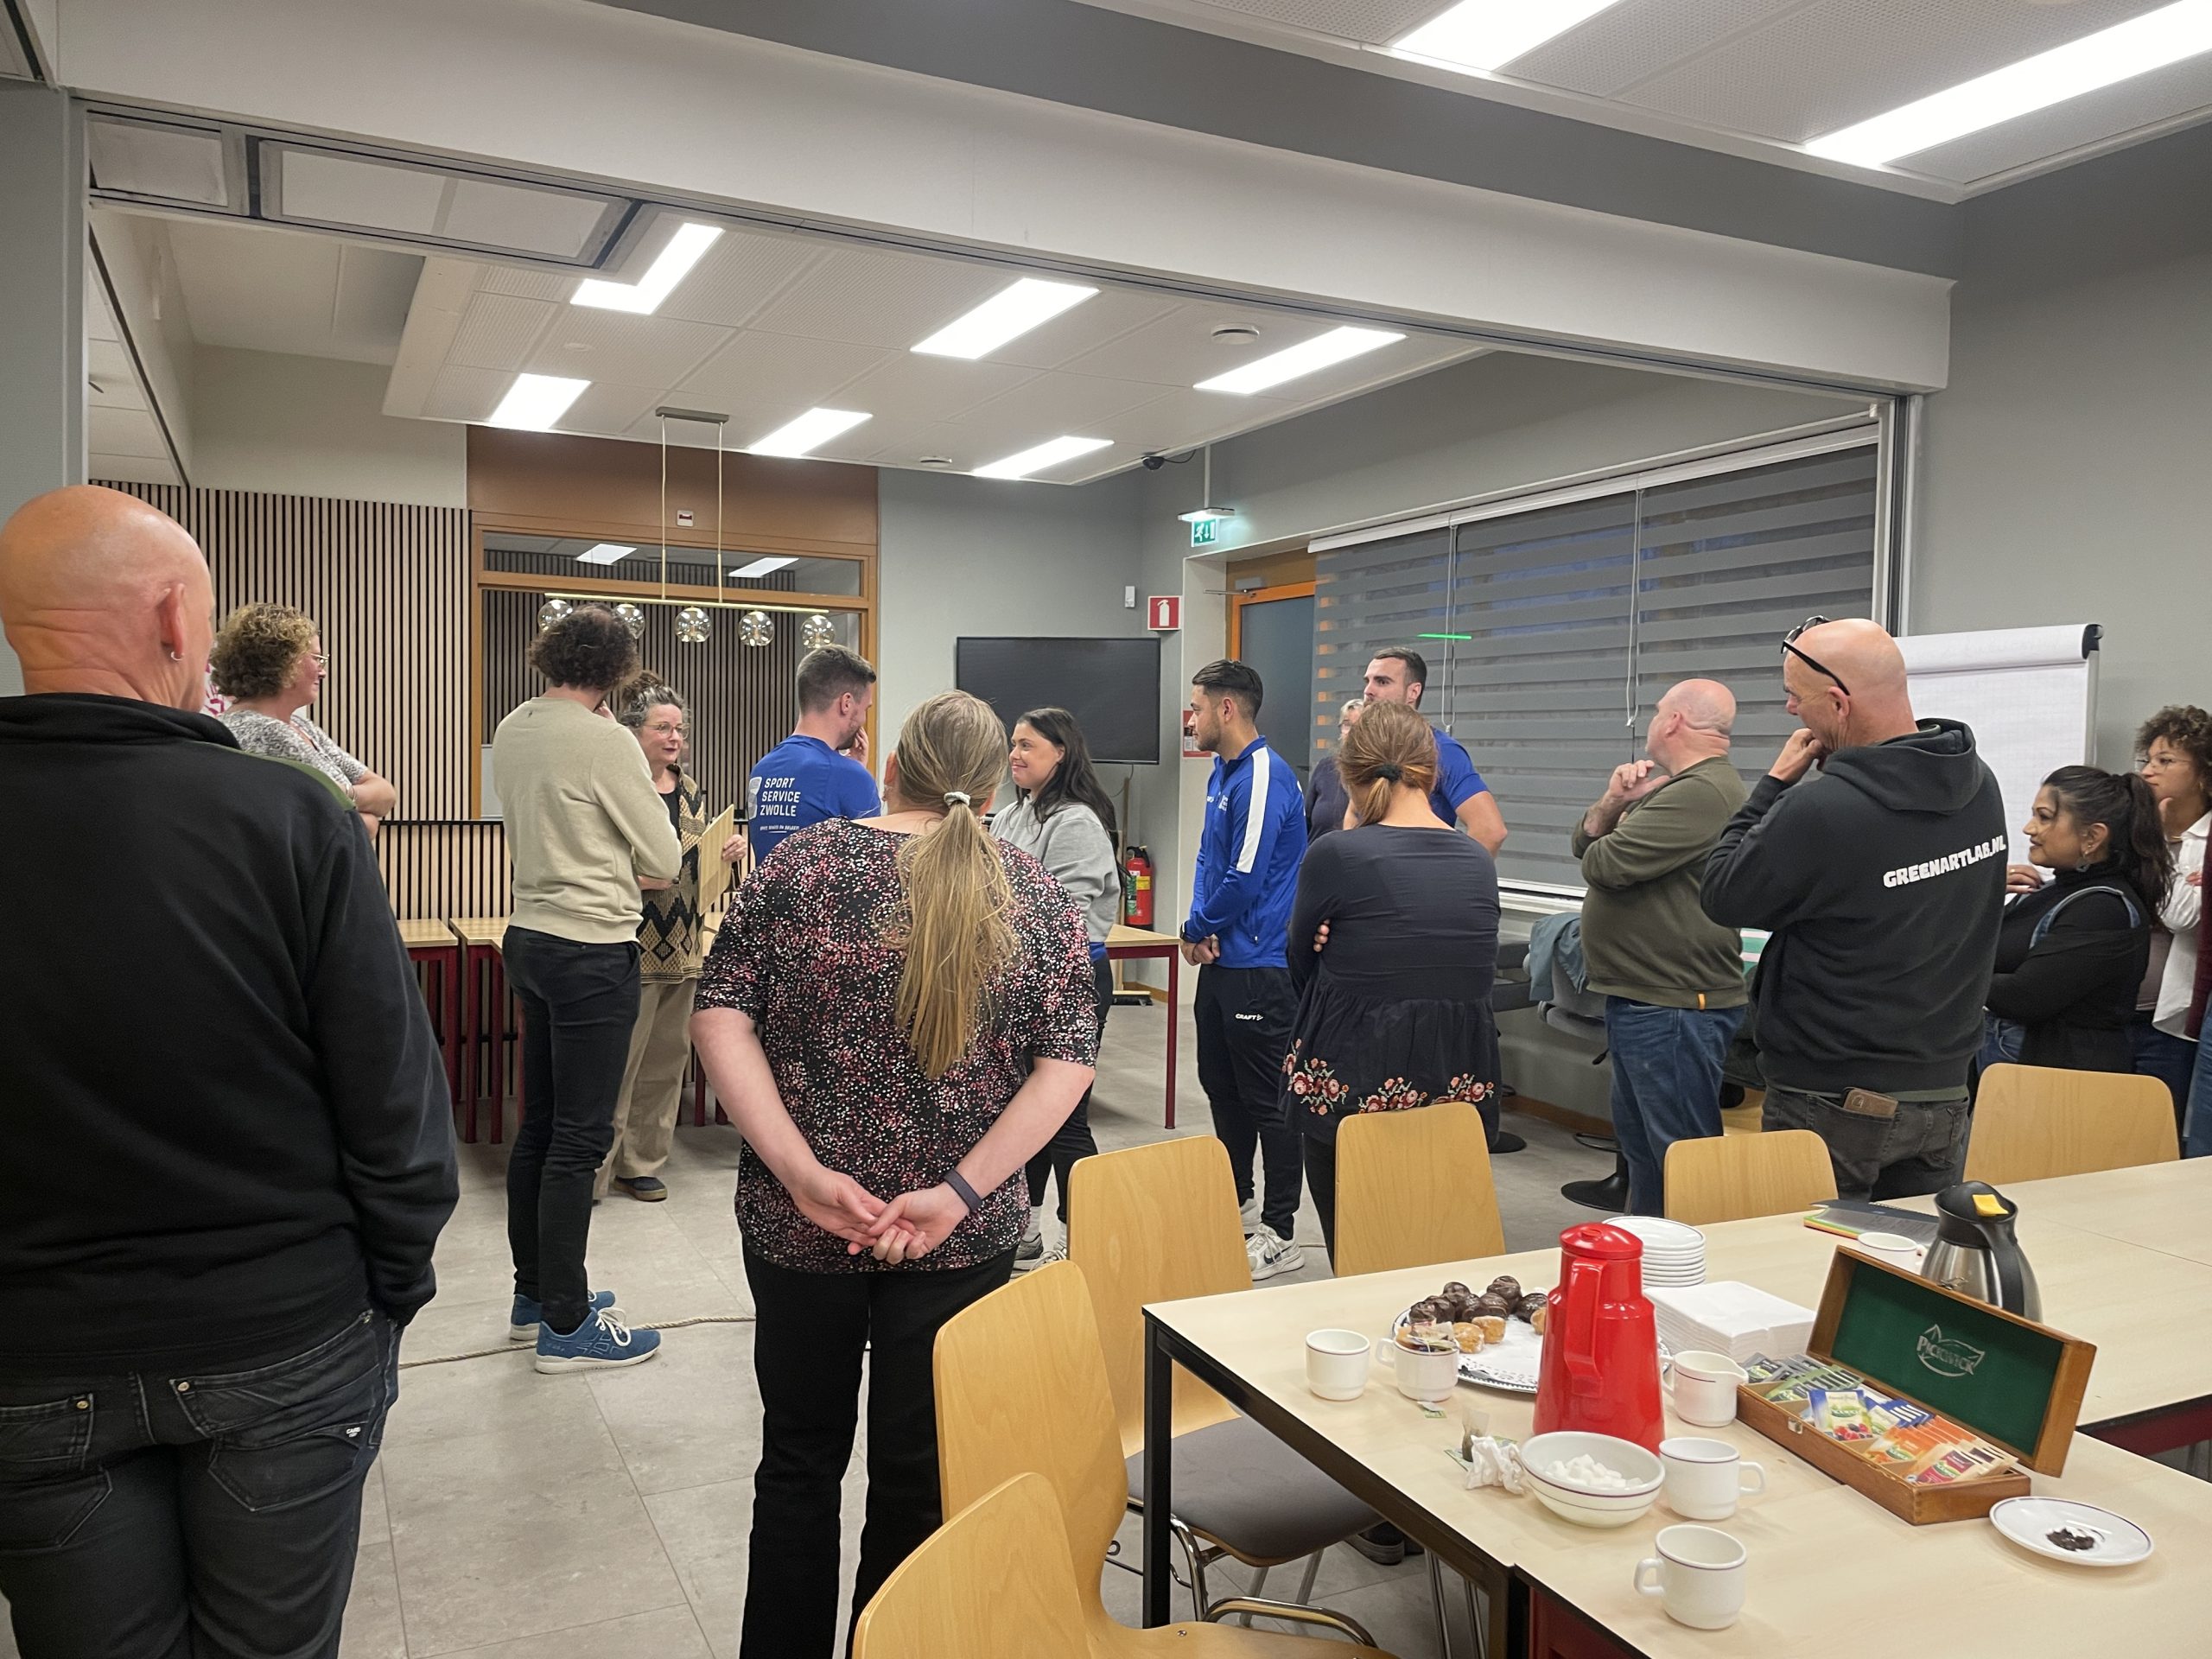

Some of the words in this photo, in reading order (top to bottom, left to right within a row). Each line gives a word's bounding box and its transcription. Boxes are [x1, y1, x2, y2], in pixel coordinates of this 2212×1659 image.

[765, 778, 795, 789] SPORT
[762, 791, 801, 803] SERVICE
[760, 804, 797, 817] ZWOLLE
[1883, 835, 2006, 888] GREENARTLAB.NL
